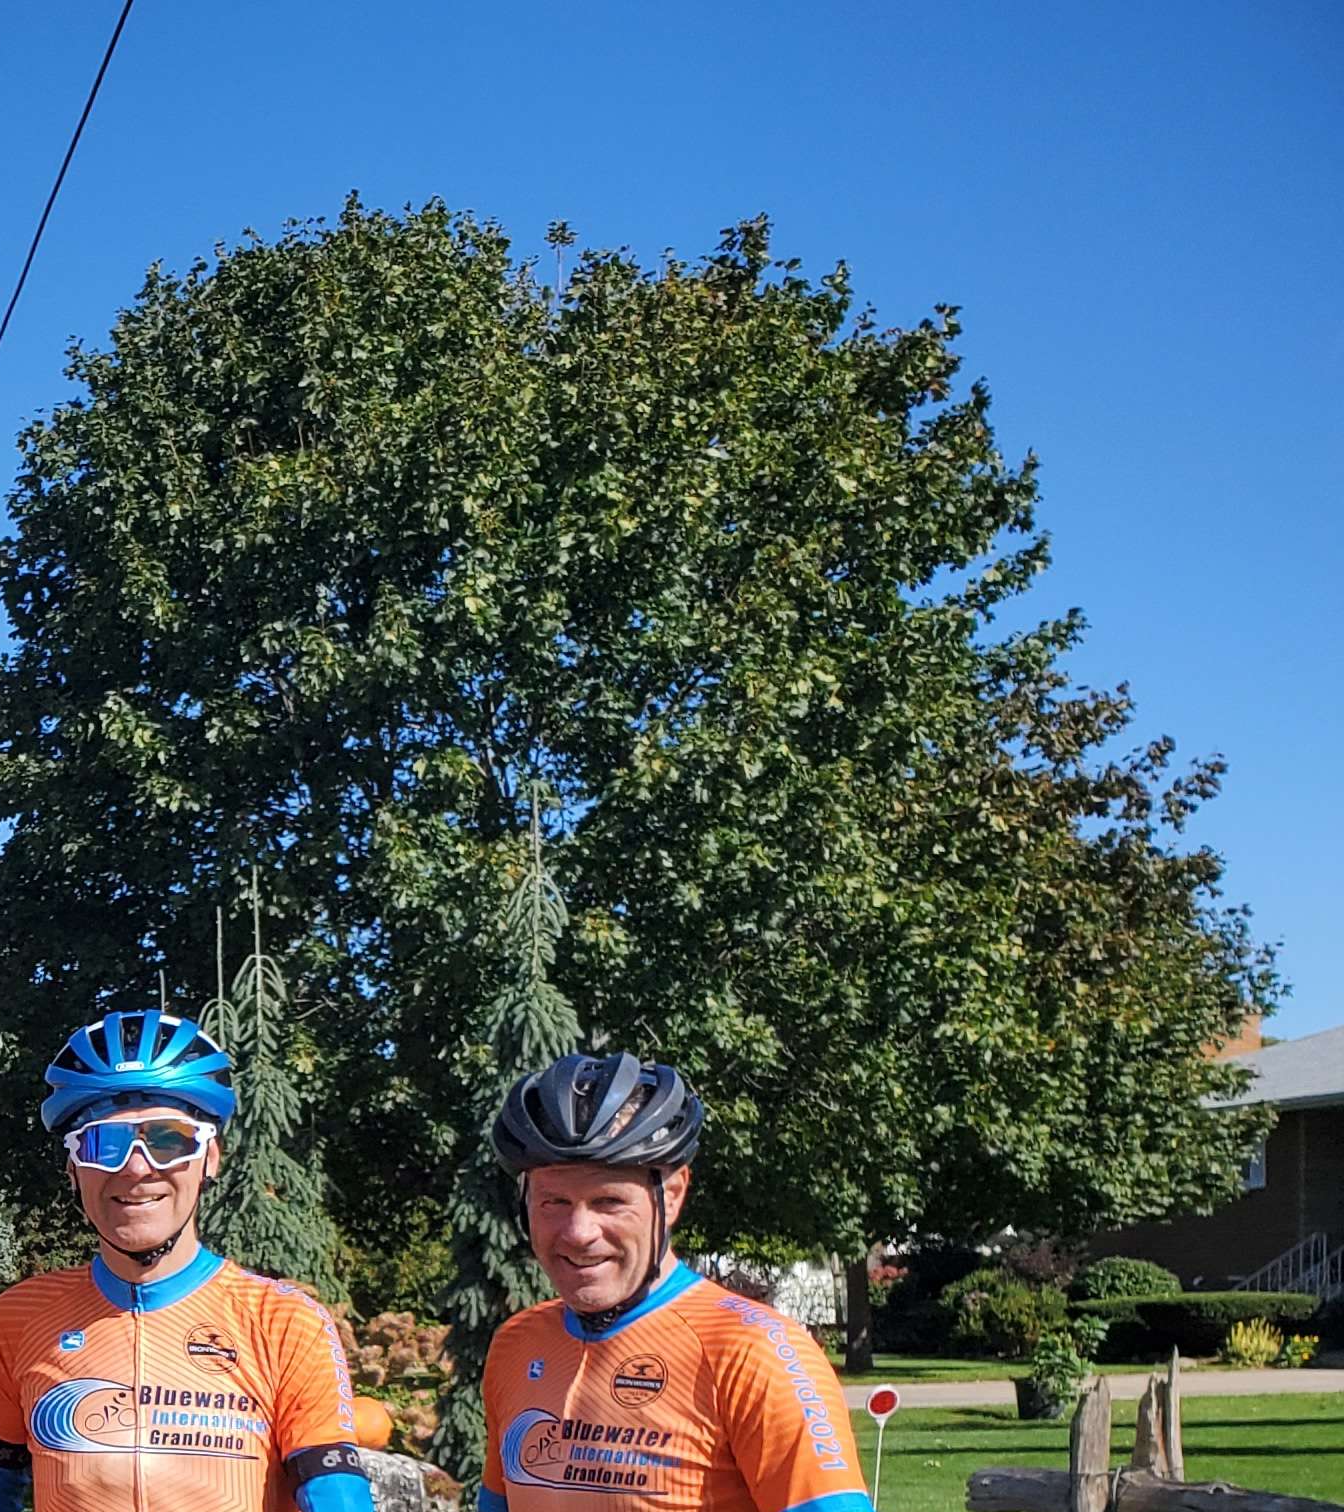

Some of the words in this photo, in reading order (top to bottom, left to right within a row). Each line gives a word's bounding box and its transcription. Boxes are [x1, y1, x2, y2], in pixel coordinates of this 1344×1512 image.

[139, 1385, 258, 1412] Bluewater
[150, 1429, 243, 1450] Granfondo
[561, 1419, 672, 1448] Bluewater
[563, 1464, 647, 1486] Granfondo
